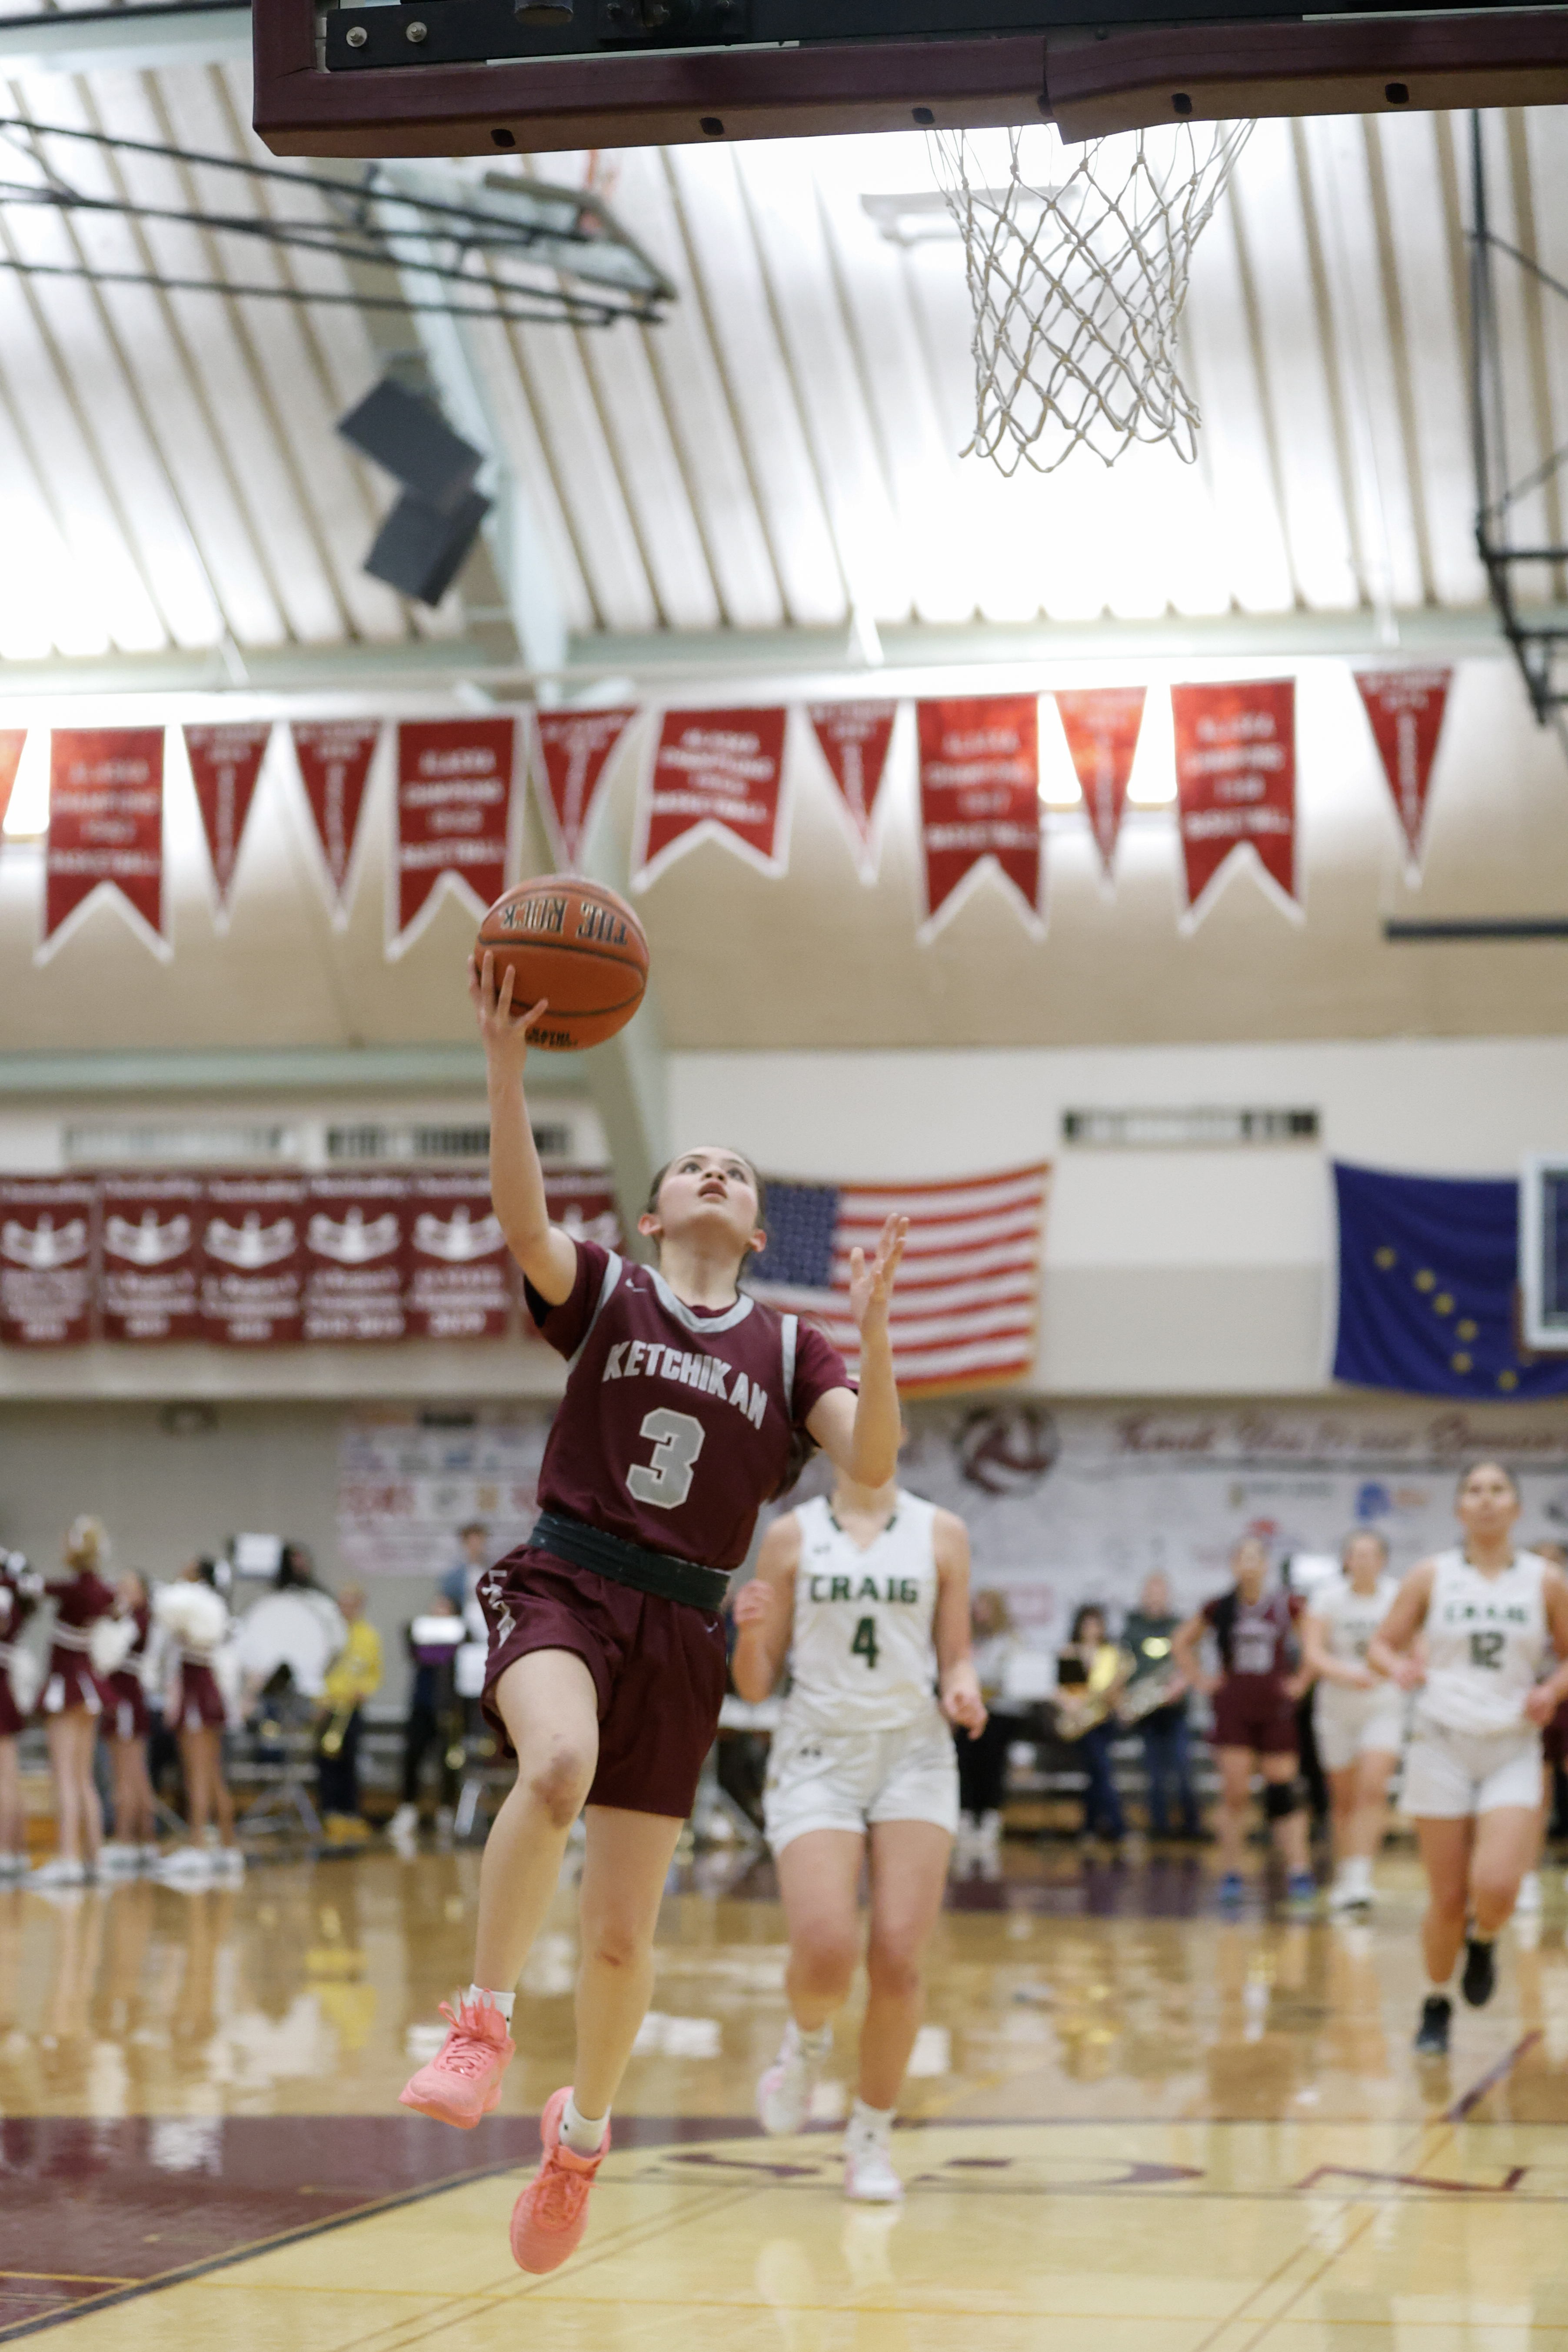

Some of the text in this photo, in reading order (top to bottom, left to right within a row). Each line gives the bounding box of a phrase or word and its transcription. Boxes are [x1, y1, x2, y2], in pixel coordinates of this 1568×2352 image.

[500, 897, 627, 946] THE ROCK
[603, 1339, 768, 1430] KETCHIKAN
[626, 1407, 706, 1509] 3
[810, 1575, 919, 1604] CRAIG
[852, 1616, 879, 1669] 4
